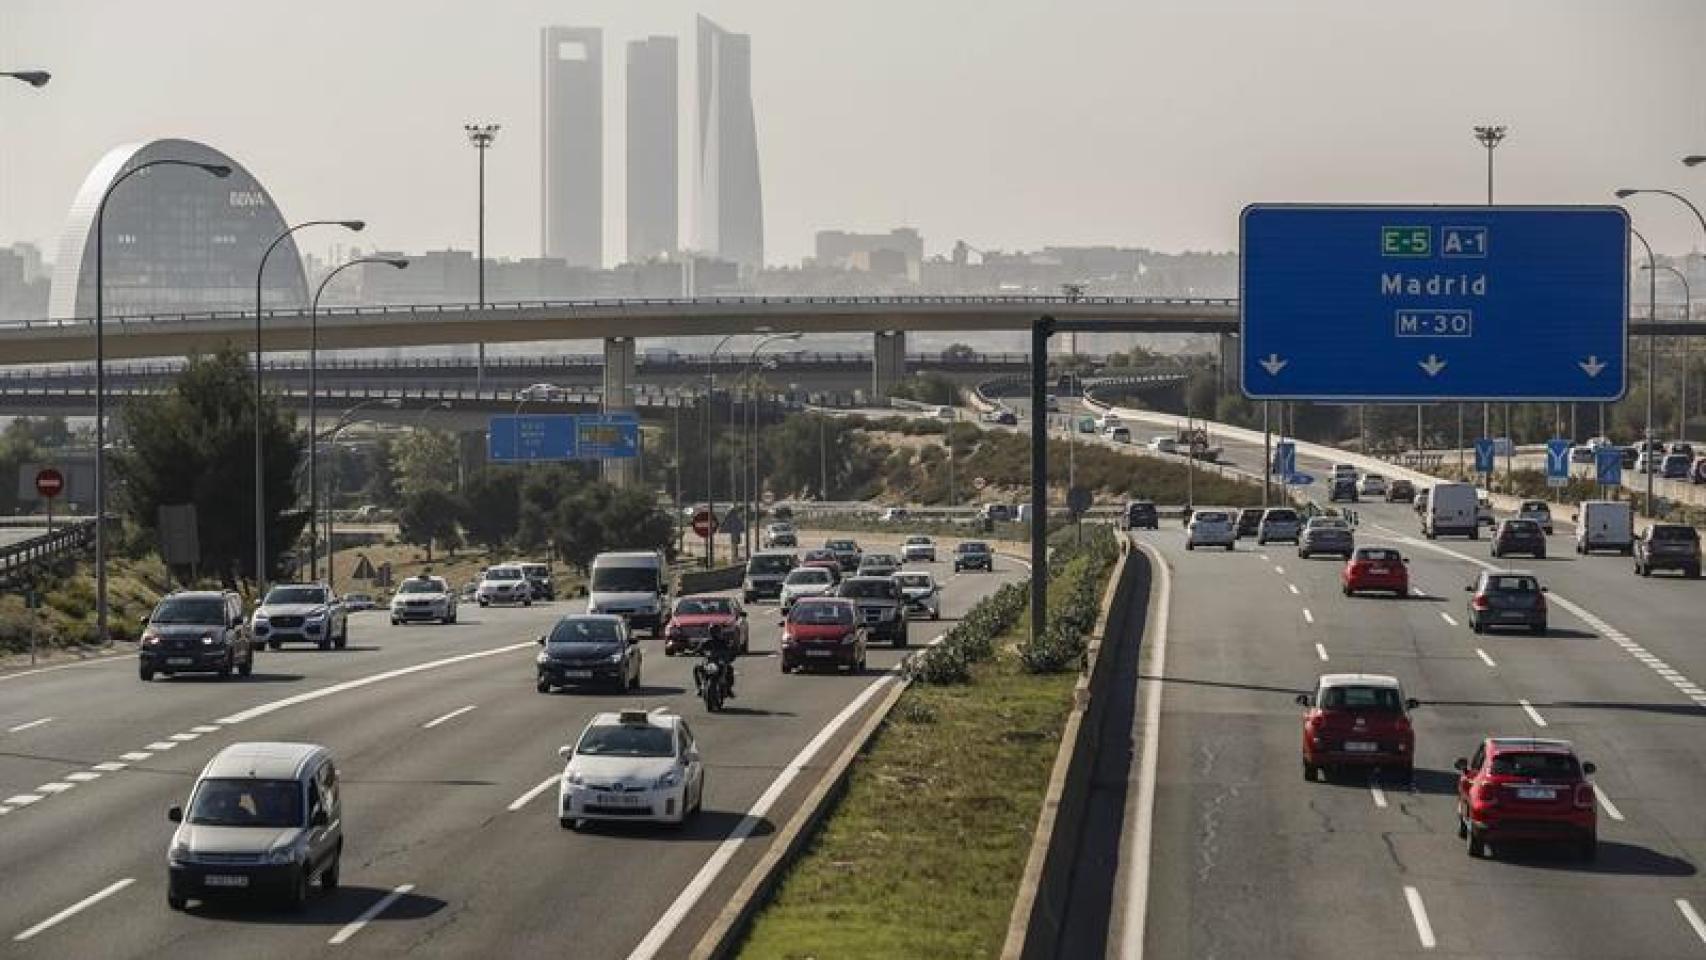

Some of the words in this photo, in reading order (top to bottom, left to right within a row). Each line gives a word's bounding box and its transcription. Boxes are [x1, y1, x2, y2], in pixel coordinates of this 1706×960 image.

[229, 191, 264, 206] BBVA
[1385, 231, 1428, 252] E-5
[1445, 231, 1484, 252] A-1
[1381, 272, 1485, 296] Madrid
[1400, 315, 1466, 332] M-30
